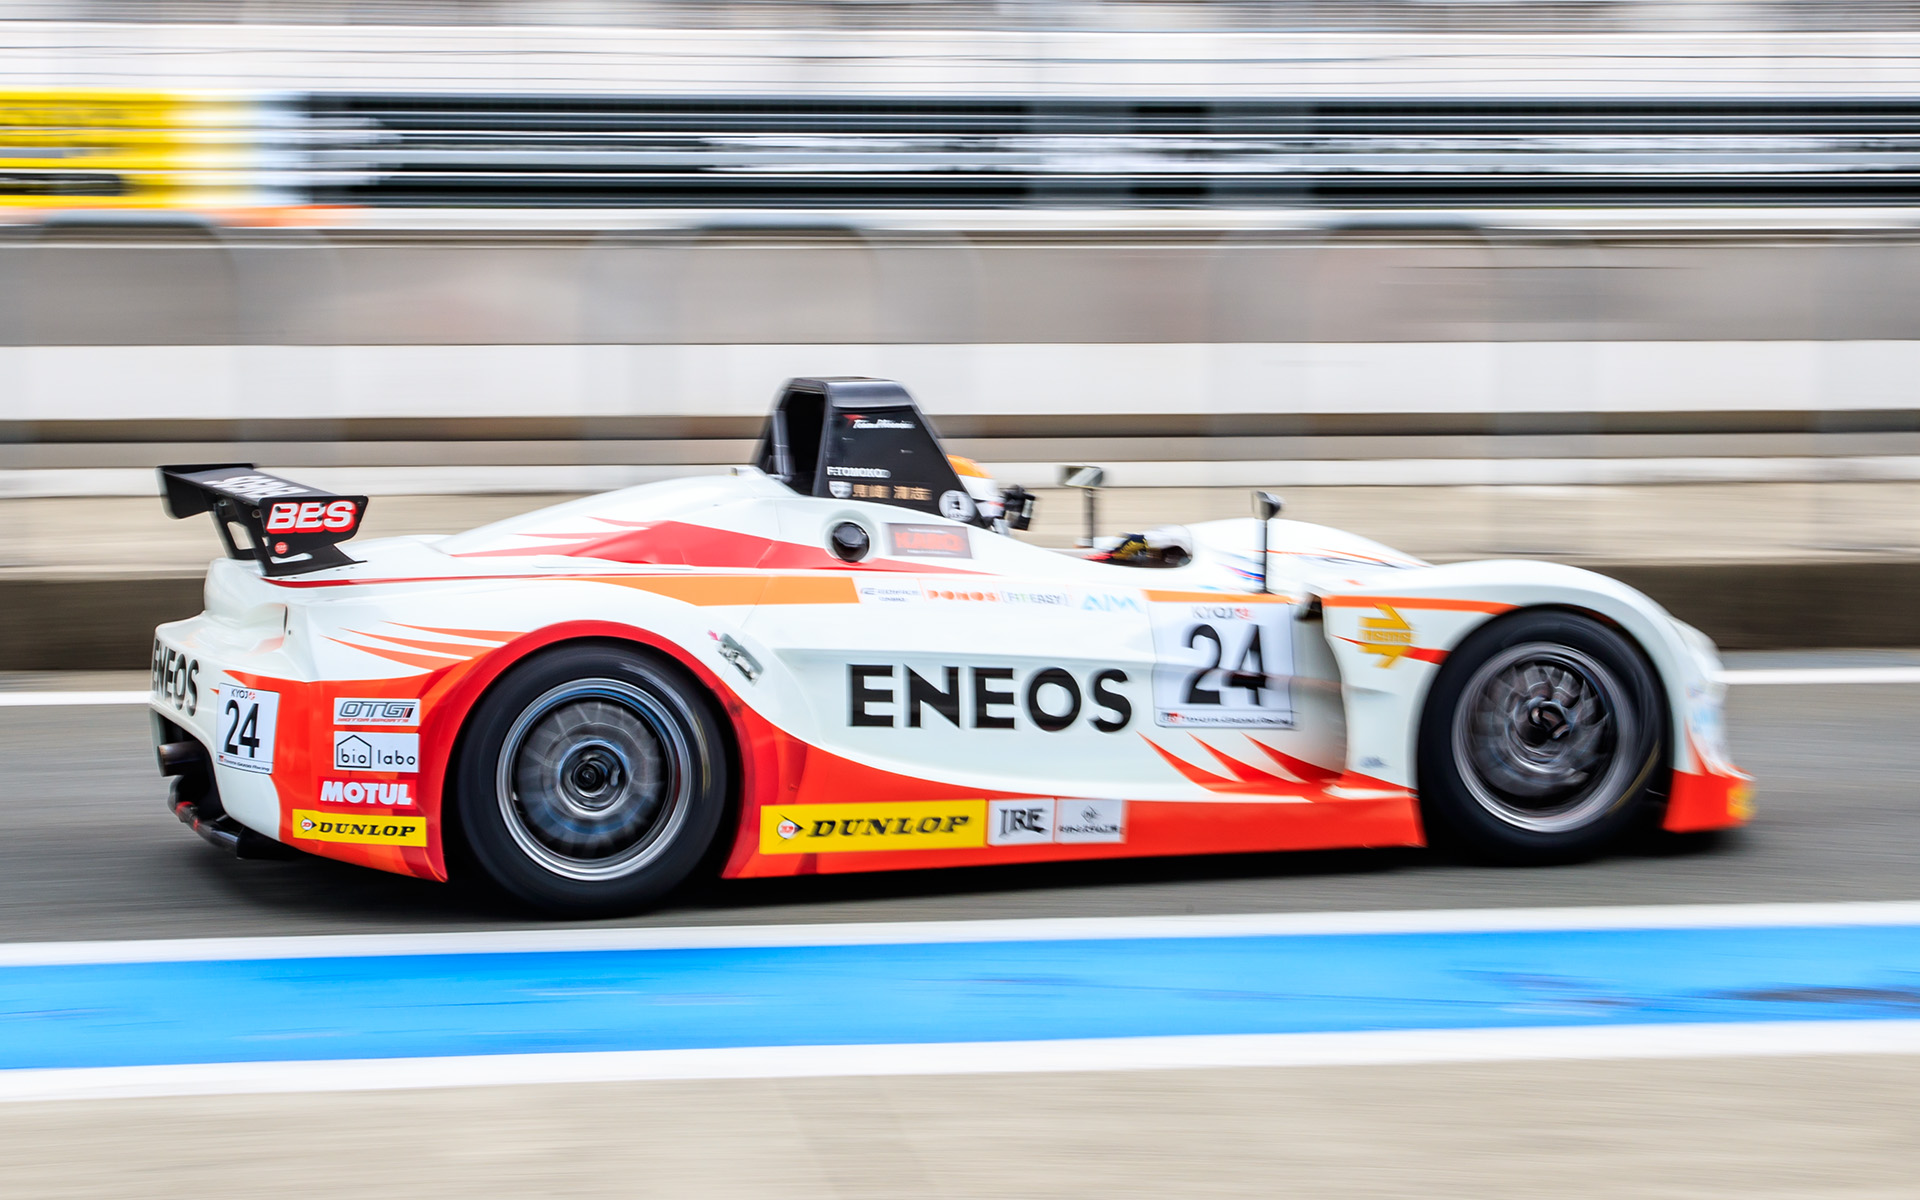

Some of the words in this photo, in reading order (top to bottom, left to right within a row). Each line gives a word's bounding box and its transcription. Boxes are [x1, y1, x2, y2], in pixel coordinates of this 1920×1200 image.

[266, 501, 358, 534] BBS
[152, 638, 199, 717] ENEOS
[1181, 623, 1267, 706] 24
[846, 663, 1132, 733] ENEOS
[223, 699, 260, 758] 24
[341, 748, 366, 763] bio
[377, 749, 416, 765] labo
[320, 781, 412, 805] MOTUL
[319, 822, 415, 837] DUNLOP
[807, 816, 969, 837] DUNLOP
